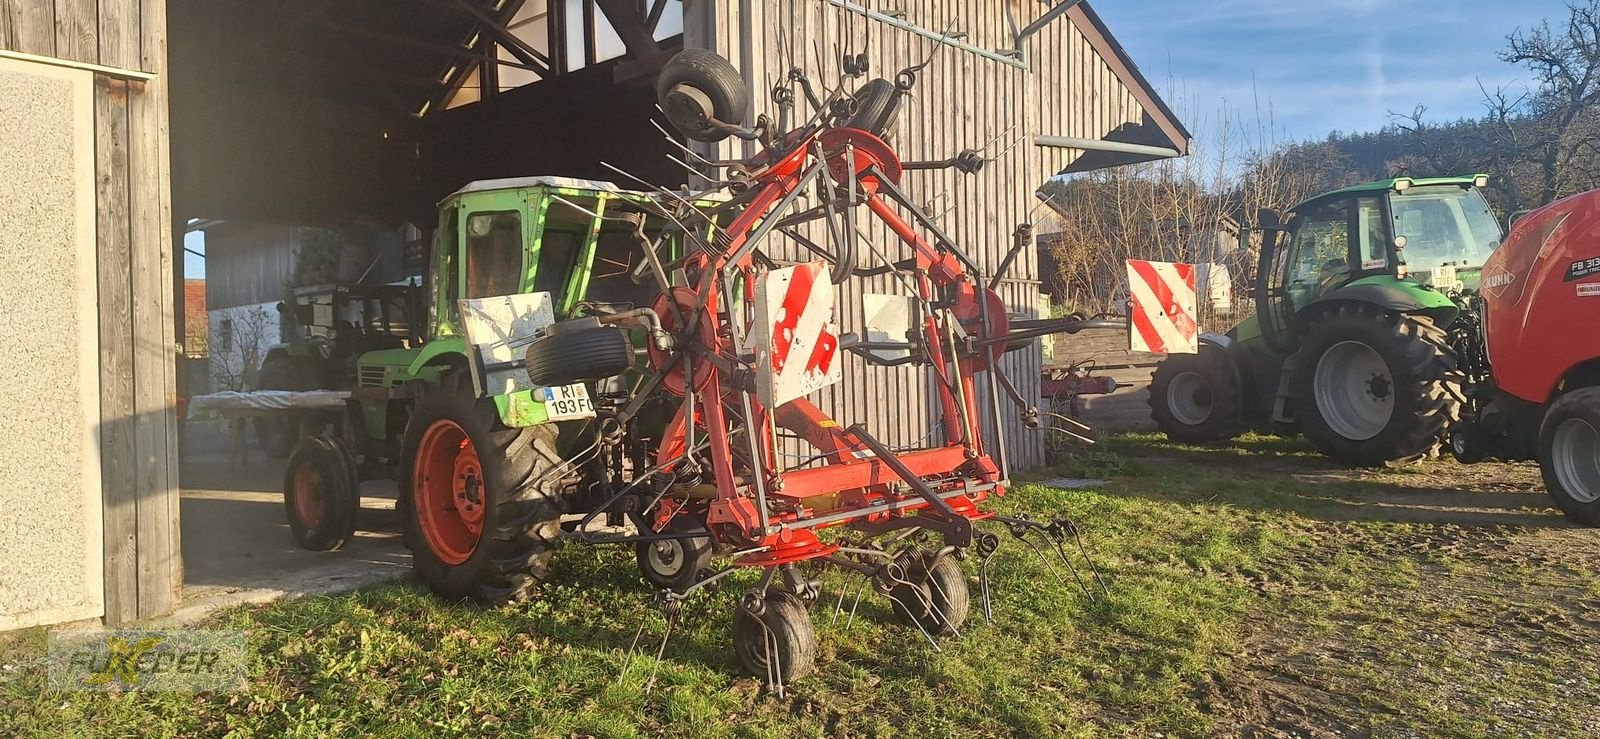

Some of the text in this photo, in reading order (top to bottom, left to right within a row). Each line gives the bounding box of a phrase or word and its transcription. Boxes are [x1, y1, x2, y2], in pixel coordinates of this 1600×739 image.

[1571, 261, 1584, 271] FB
[1486, 273, 1510, 288] KUHN
[561, 385, 575, 398] RI
